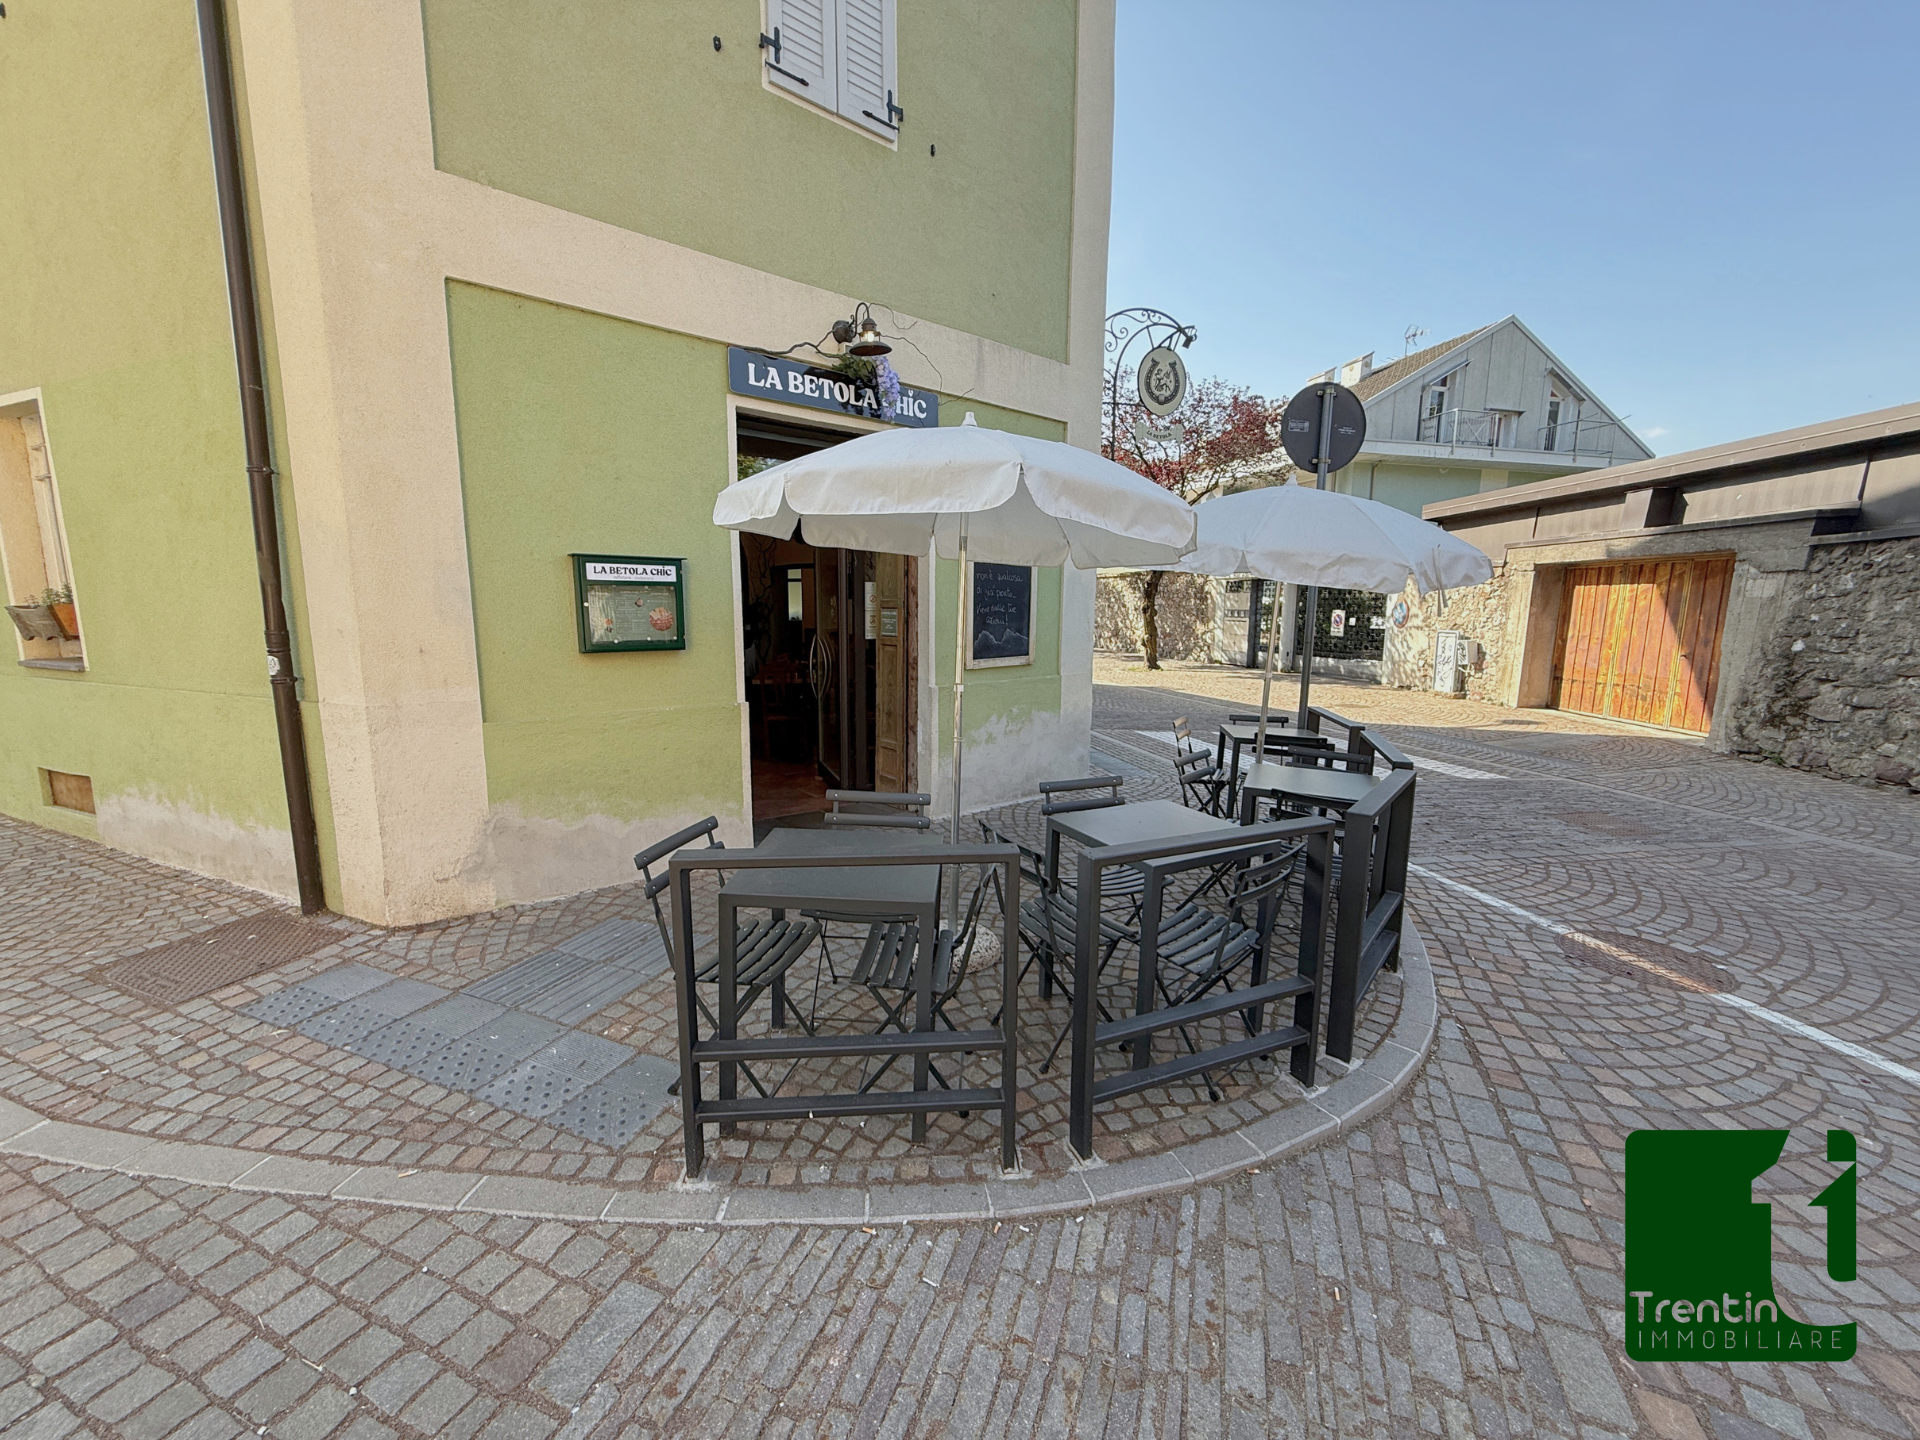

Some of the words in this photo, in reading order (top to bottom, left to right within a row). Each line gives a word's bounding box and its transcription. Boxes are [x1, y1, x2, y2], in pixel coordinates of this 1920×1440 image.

[747, 362, 783, 391] LA
[787, 371, 878, 409] BETOLA
[593, 565, 607, 574] LA
[609, 566, 648, 576] BETOLA
